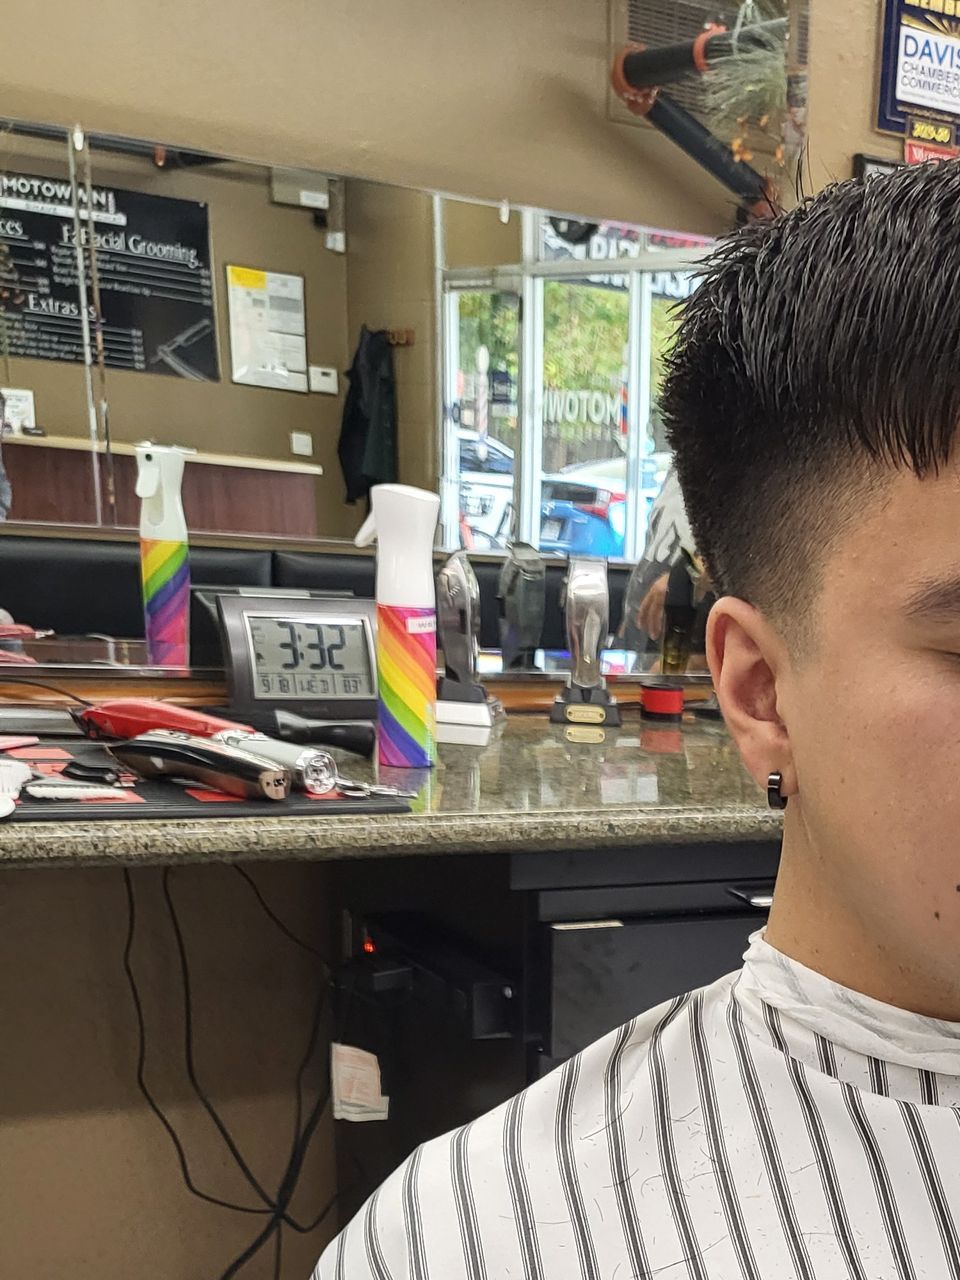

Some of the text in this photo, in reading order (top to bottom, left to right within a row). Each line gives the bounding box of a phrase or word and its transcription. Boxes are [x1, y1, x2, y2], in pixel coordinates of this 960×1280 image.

[901, 61, 960, 84] CHAMBER
[128, 235, 198, 269] Grooming
[28, 294, 78, 315] Extras
[277, 621, 345, 670] 3:32
